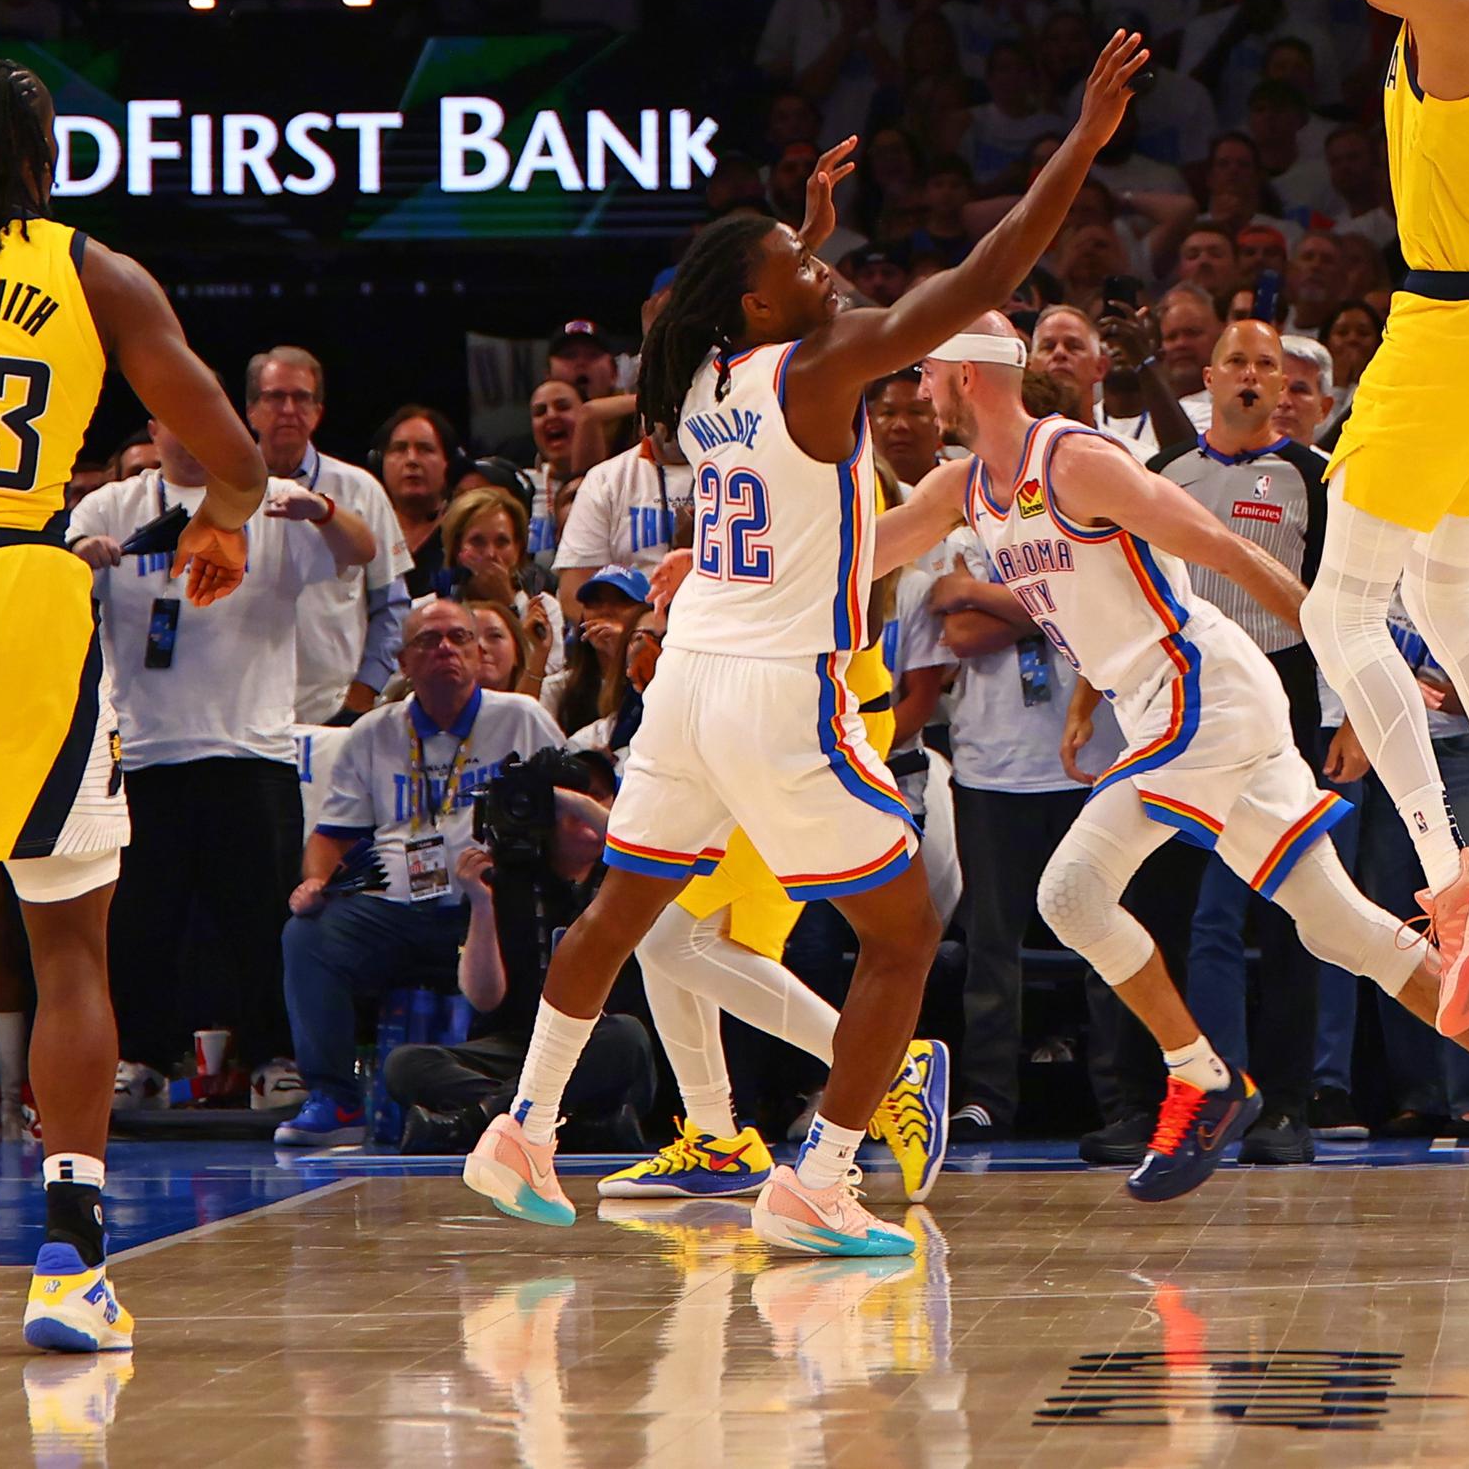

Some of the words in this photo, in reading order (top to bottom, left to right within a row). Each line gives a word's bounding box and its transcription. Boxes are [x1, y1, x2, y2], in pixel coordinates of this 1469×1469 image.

[440, 96, 720, 193] BANK
[684, 408, 763, 453] WALLACE
[697, 461, 774, 585] 22
[1233, 503, 1281, 520] Emirates
